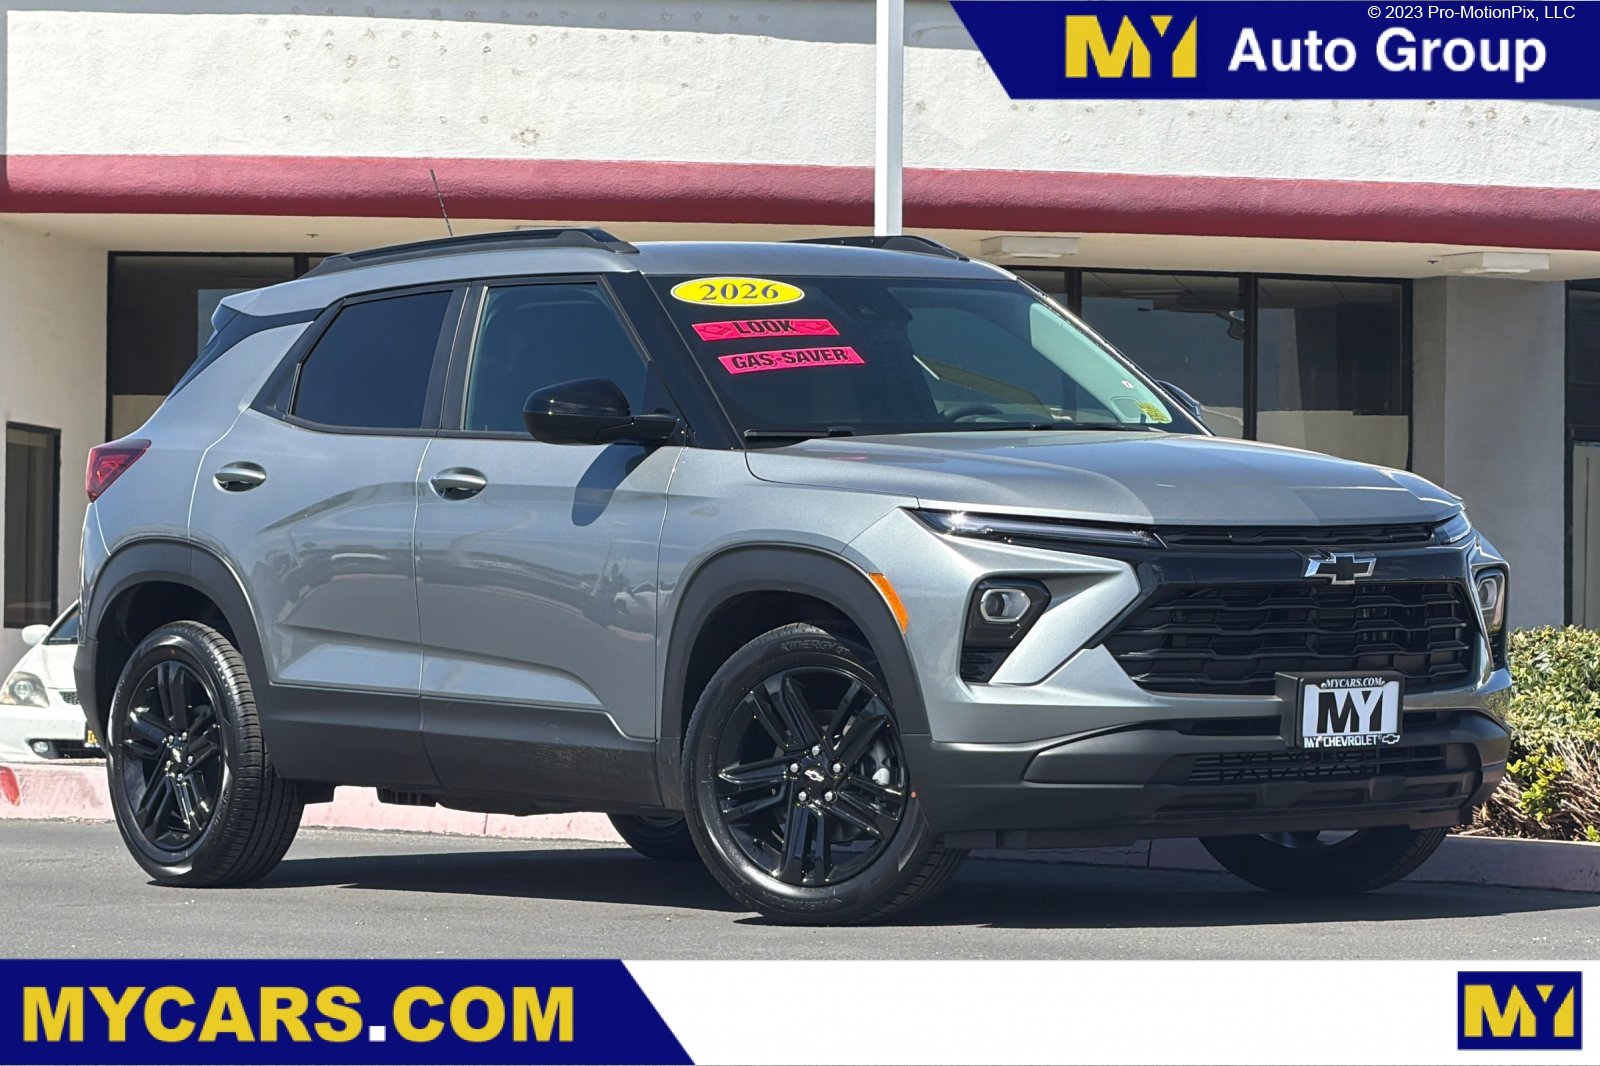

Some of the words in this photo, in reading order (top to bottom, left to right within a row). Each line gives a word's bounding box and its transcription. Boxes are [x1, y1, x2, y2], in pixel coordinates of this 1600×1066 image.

[699, 283, 779, 301] 2026
[732, 320, 796, 334] LOOK
[732, 349, 848, 369] GAS-SAVER
[1326, 677, 1382, 687] MYCARS.COM
[1317, 691, 1383, 733] MY
